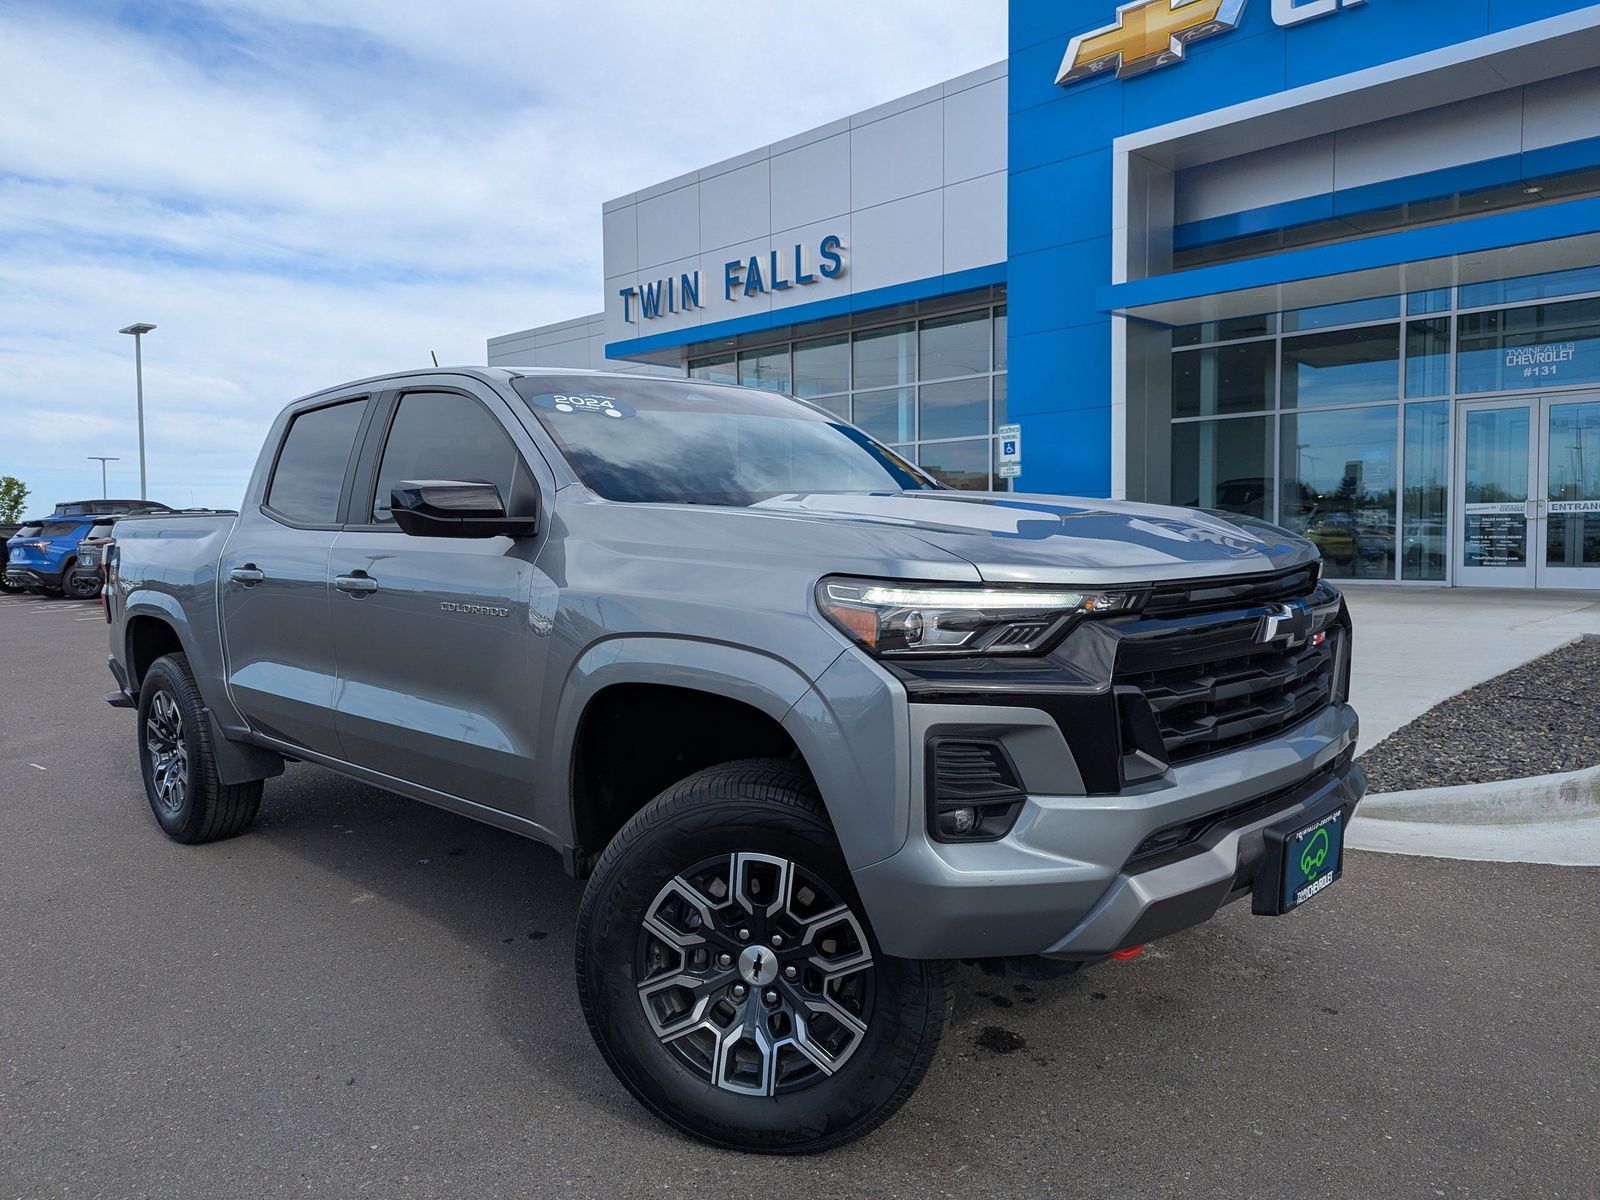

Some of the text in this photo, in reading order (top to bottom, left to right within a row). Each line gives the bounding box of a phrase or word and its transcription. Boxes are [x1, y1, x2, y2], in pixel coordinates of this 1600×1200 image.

[619, 234, 846, 323] TWIN FALLS
[1506, 350, 1574, 366] CHEVROLET
[1523, 365, 1557, 377] #131
[553, 395, 615, 409] 2024
[1551, 503, 1600, 511] ENTRAN
[440, 601, 508, 617] COLORADO
